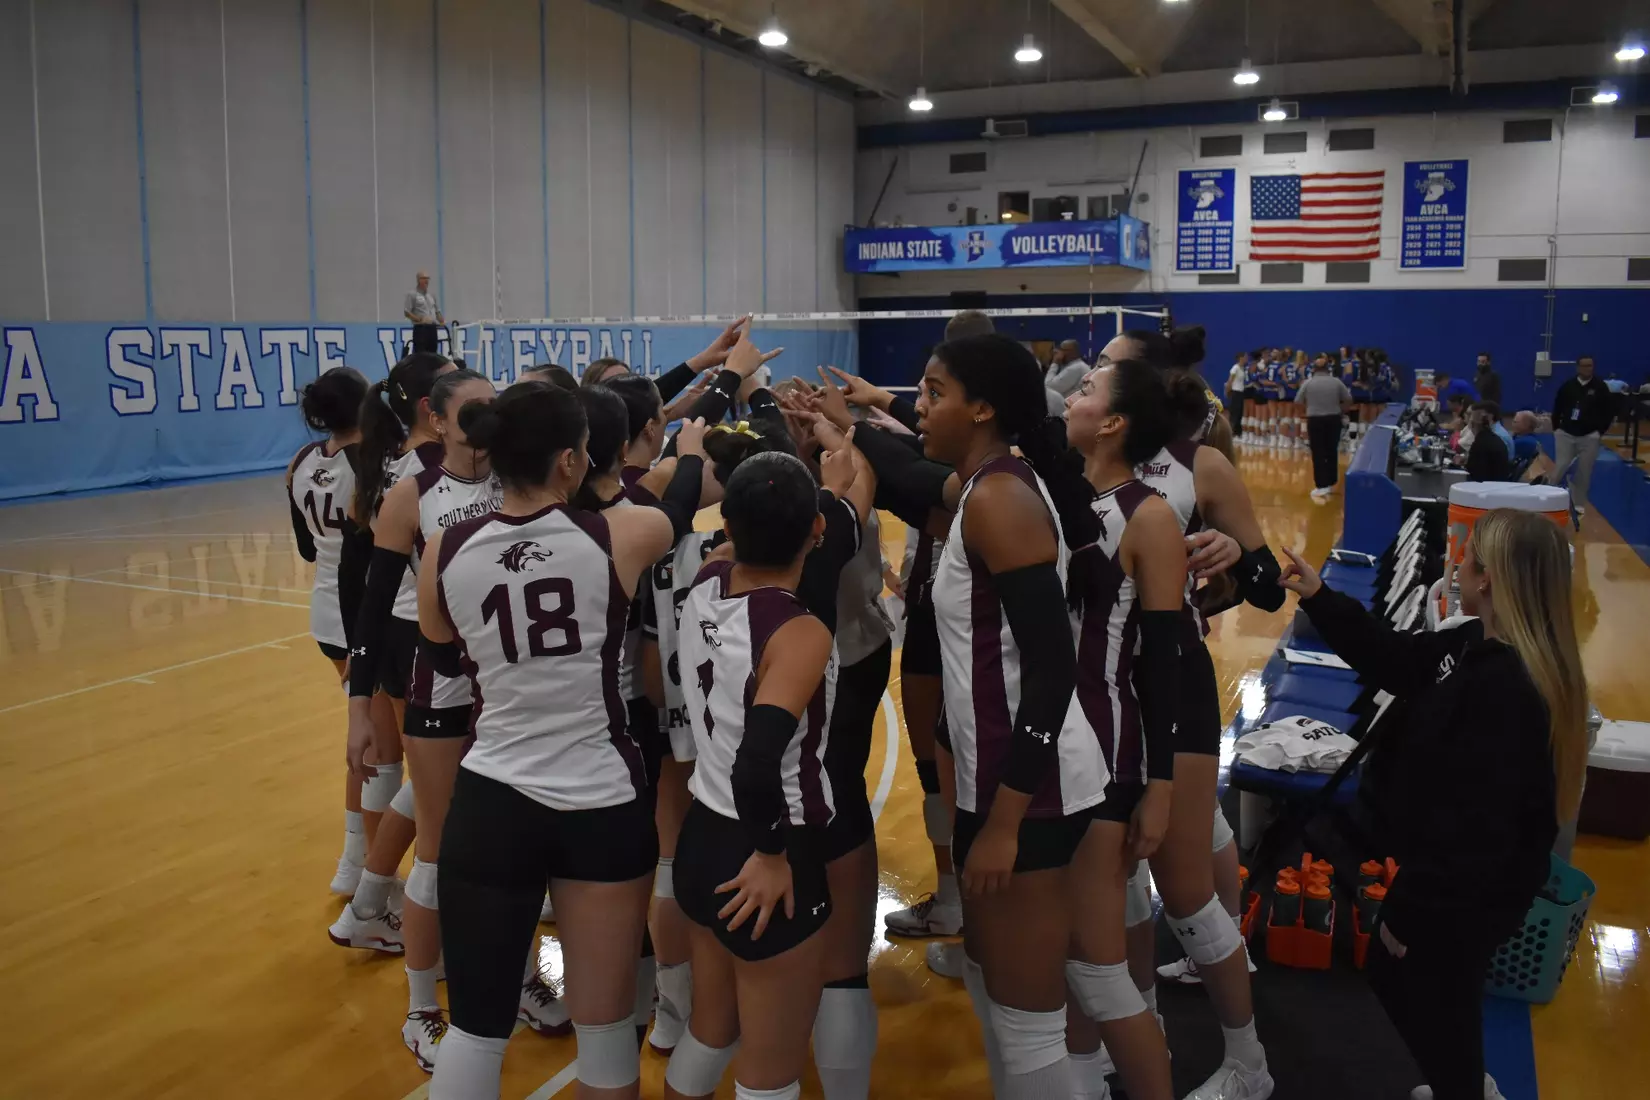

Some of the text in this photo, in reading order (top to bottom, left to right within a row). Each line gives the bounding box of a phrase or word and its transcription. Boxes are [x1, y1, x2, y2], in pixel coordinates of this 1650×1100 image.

[1193, 209, 1219, 221] AVCA
[1420, 204, 1448, 215] AVCA
[859, 243, 904, 260] INDIANA
[907, 240, 942, 258] STATE
[1012, 233, 1104, 255] VOLLEYBALL
[106, 326, 346, 417] STATE
[304, 489, 347, 536] 14
[437, 500, 488, 528] SOUTHERN
[481, 577, 582, 663] 18
